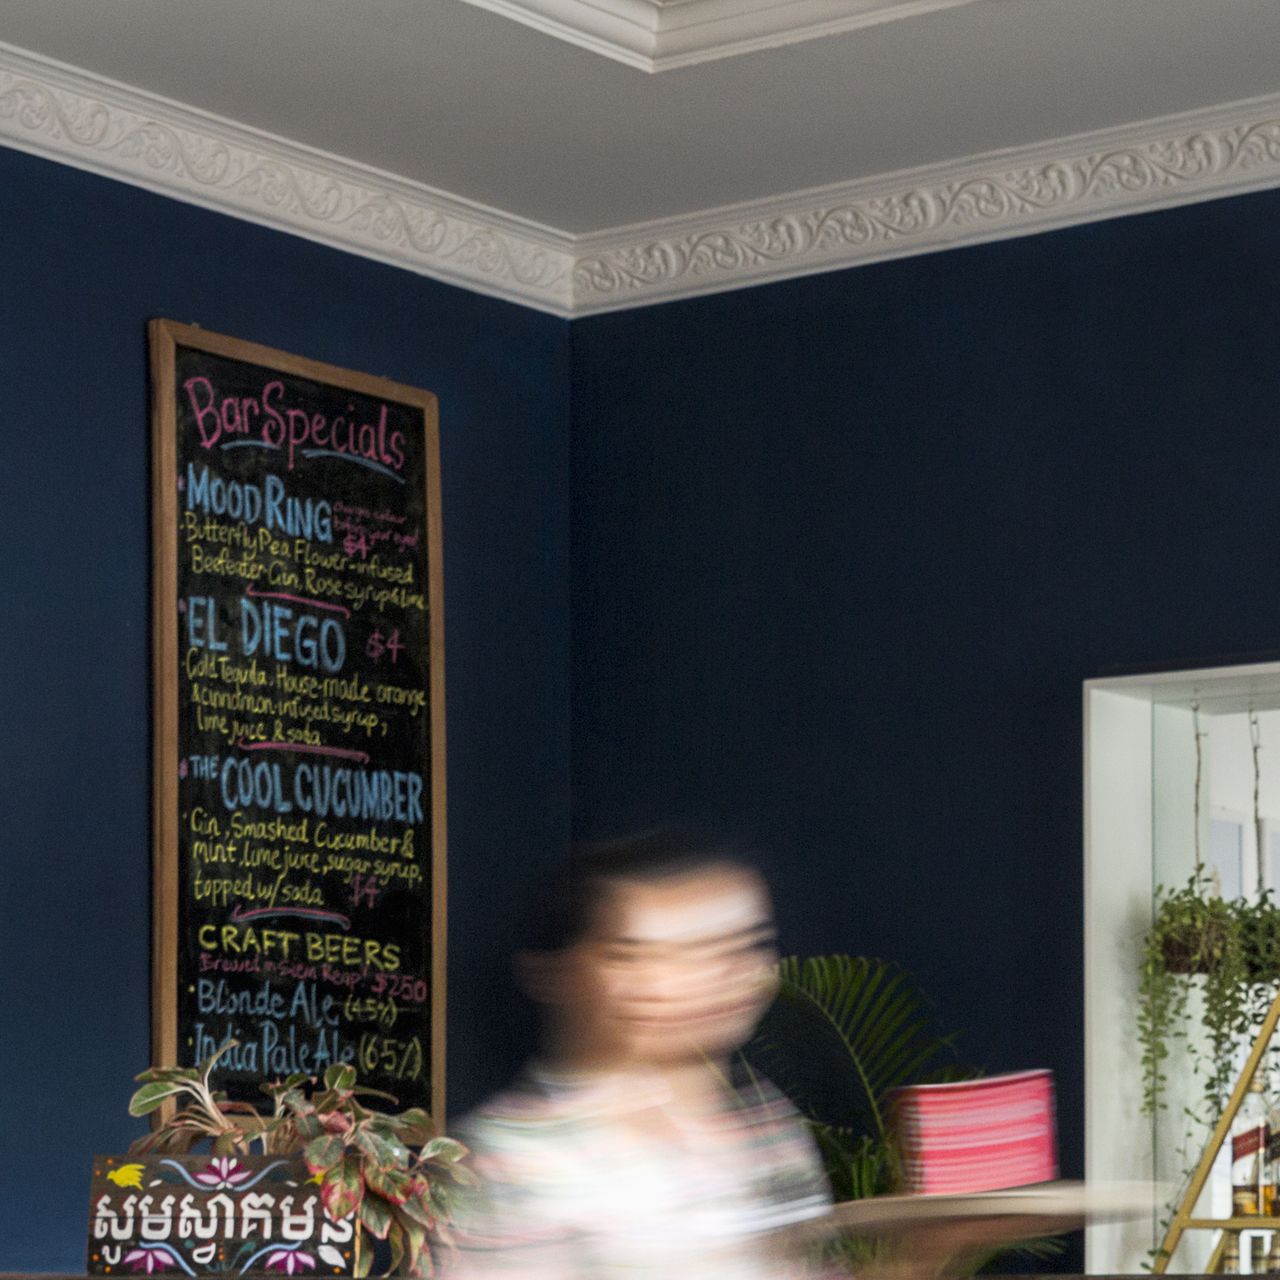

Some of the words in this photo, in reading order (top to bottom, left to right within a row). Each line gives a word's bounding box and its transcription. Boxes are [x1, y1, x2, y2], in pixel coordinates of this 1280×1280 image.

[184, 376, 259, 449] Bar
[261, 380, 406, 471] Specials
[187, 462, 262, 524] MOOD
[265, 474, 333, 544] RING
[184, 511, 257, 561] Butterfly
[258, 527, 291, 557] Pea
[304, 567, 343, 594] Rose
[188, 596, 227, 652] EL
[240, 597, 347, 673] DIEGO
[367, 628, 405, 665] $4
[196, 705, 228, 734] lime
[189, 754, 219, 779] THE
[221, 756, 293, 813] COOL
[294, 763, 423, 824] CUCUMBER
[231, 811, 309, 843] Smashed
[314, 821, 400, 855] Cucumber
[194, 869, 255, 907] topped
[199, 924, 300, 959] CRAFT
[305, 932, 401, 971] BEERS
[197, 977, 287, 1020] Blonde
[290, 980, 340, 1028] Ale
[259, 1020, 312, 1076] Pale
[93, 1192, 354, 1265] សូមស្វាគមន
